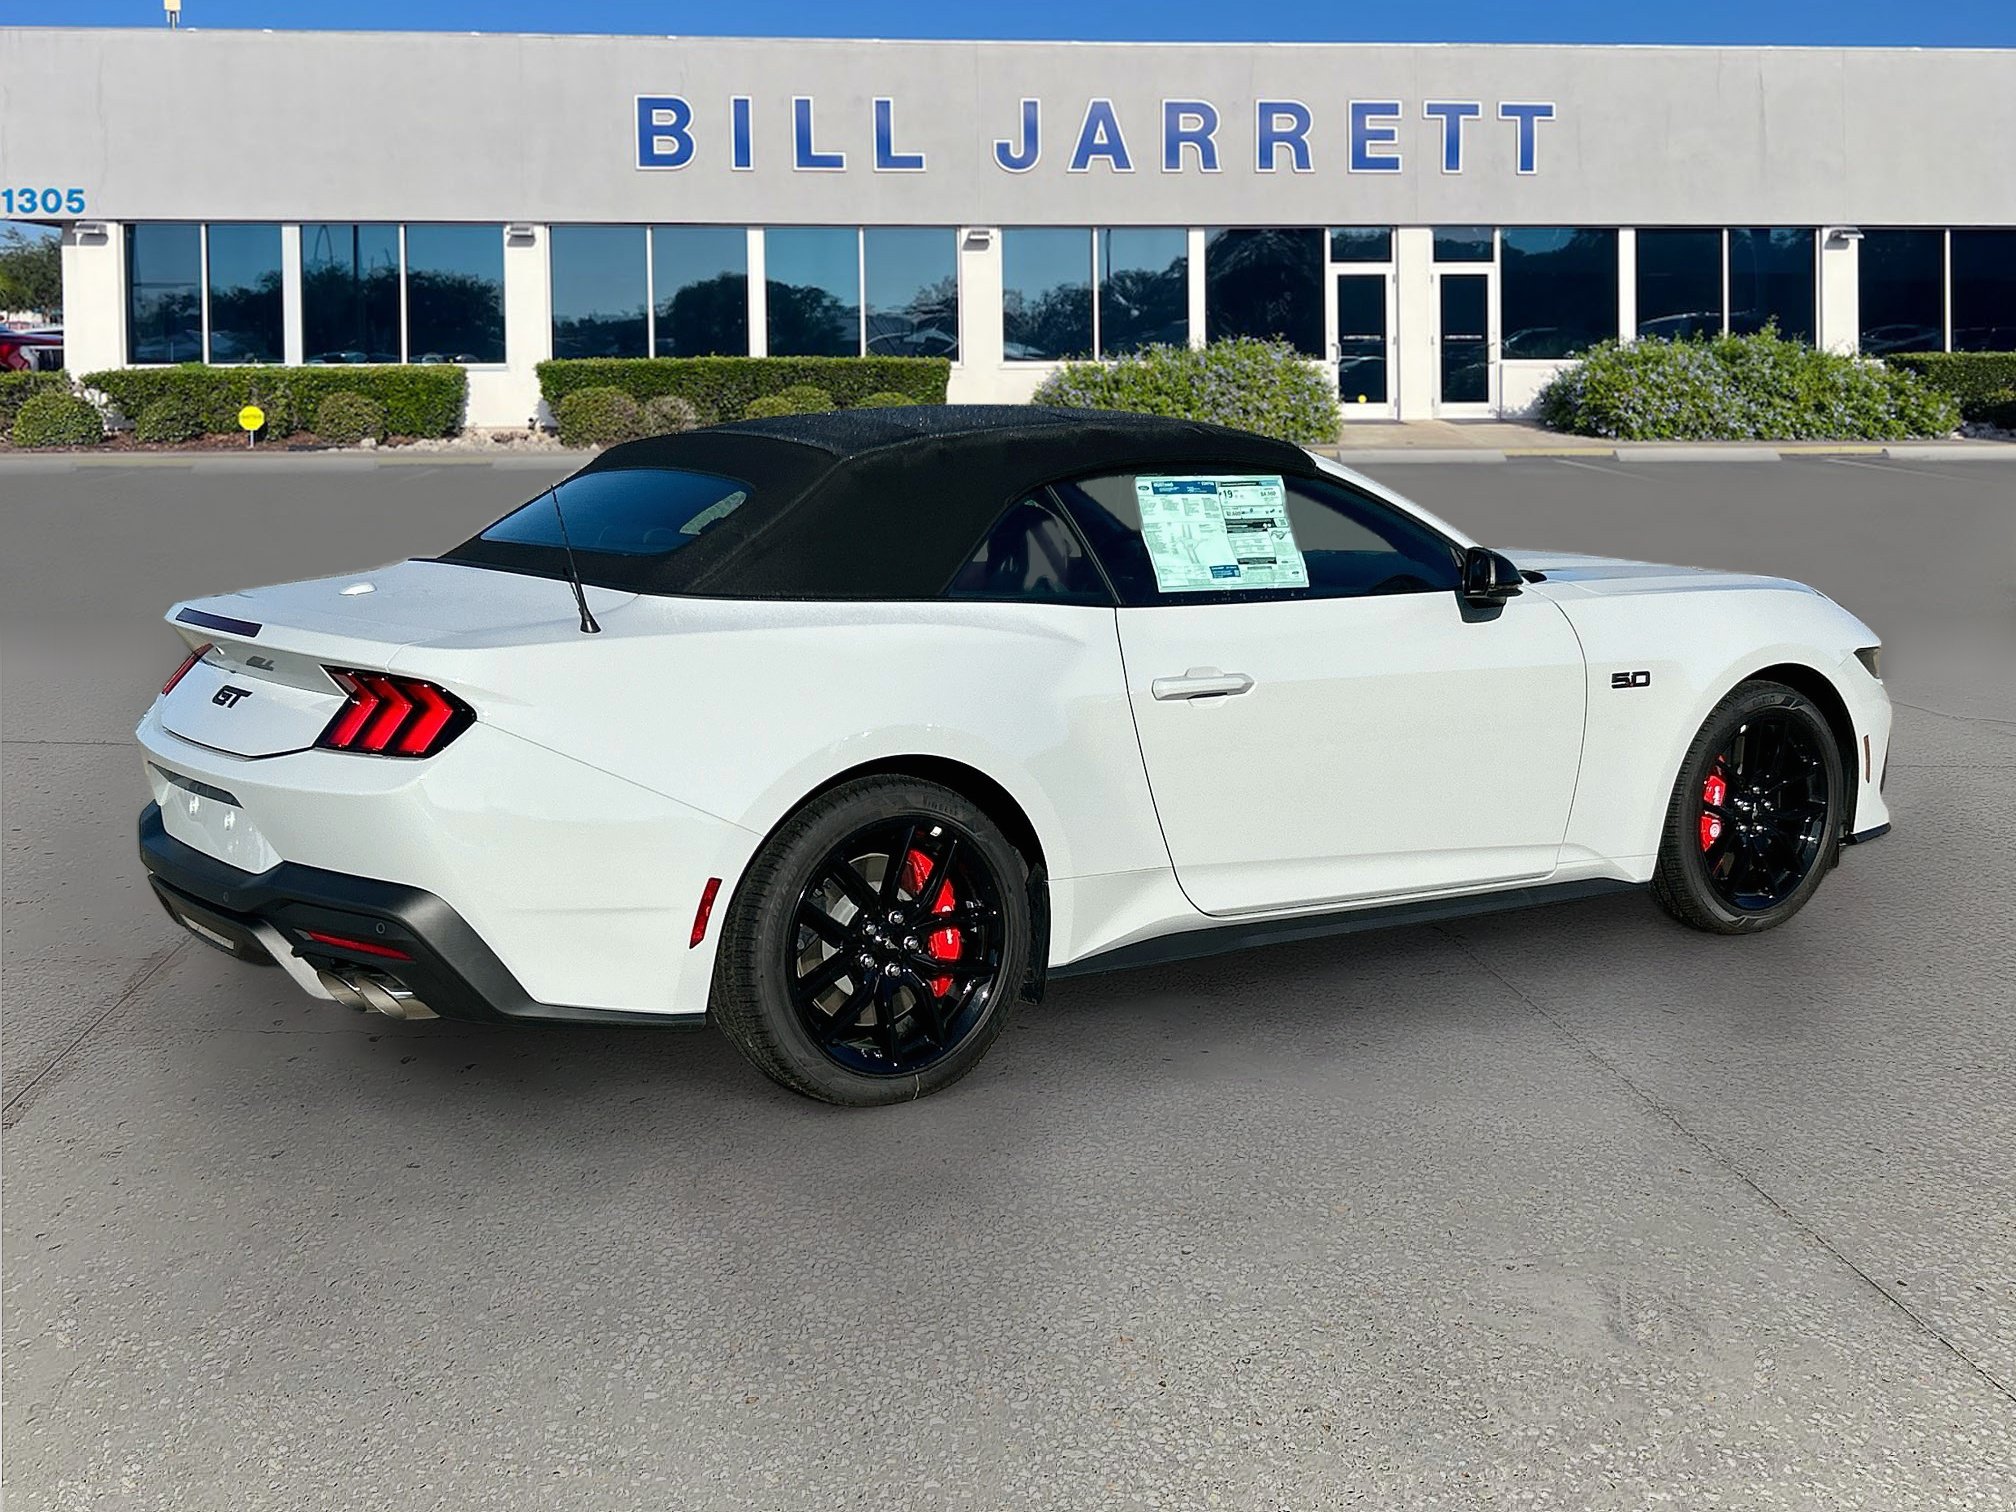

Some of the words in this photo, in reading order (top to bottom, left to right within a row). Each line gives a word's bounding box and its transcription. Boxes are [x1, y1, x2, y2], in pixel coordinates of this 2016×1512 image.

[636, 94, 926, 171] BILL
[994, 99, 1556, 174] JARRETT
[2, 187, 86, 214] 1305
[212, 684, 254, 709] GT
